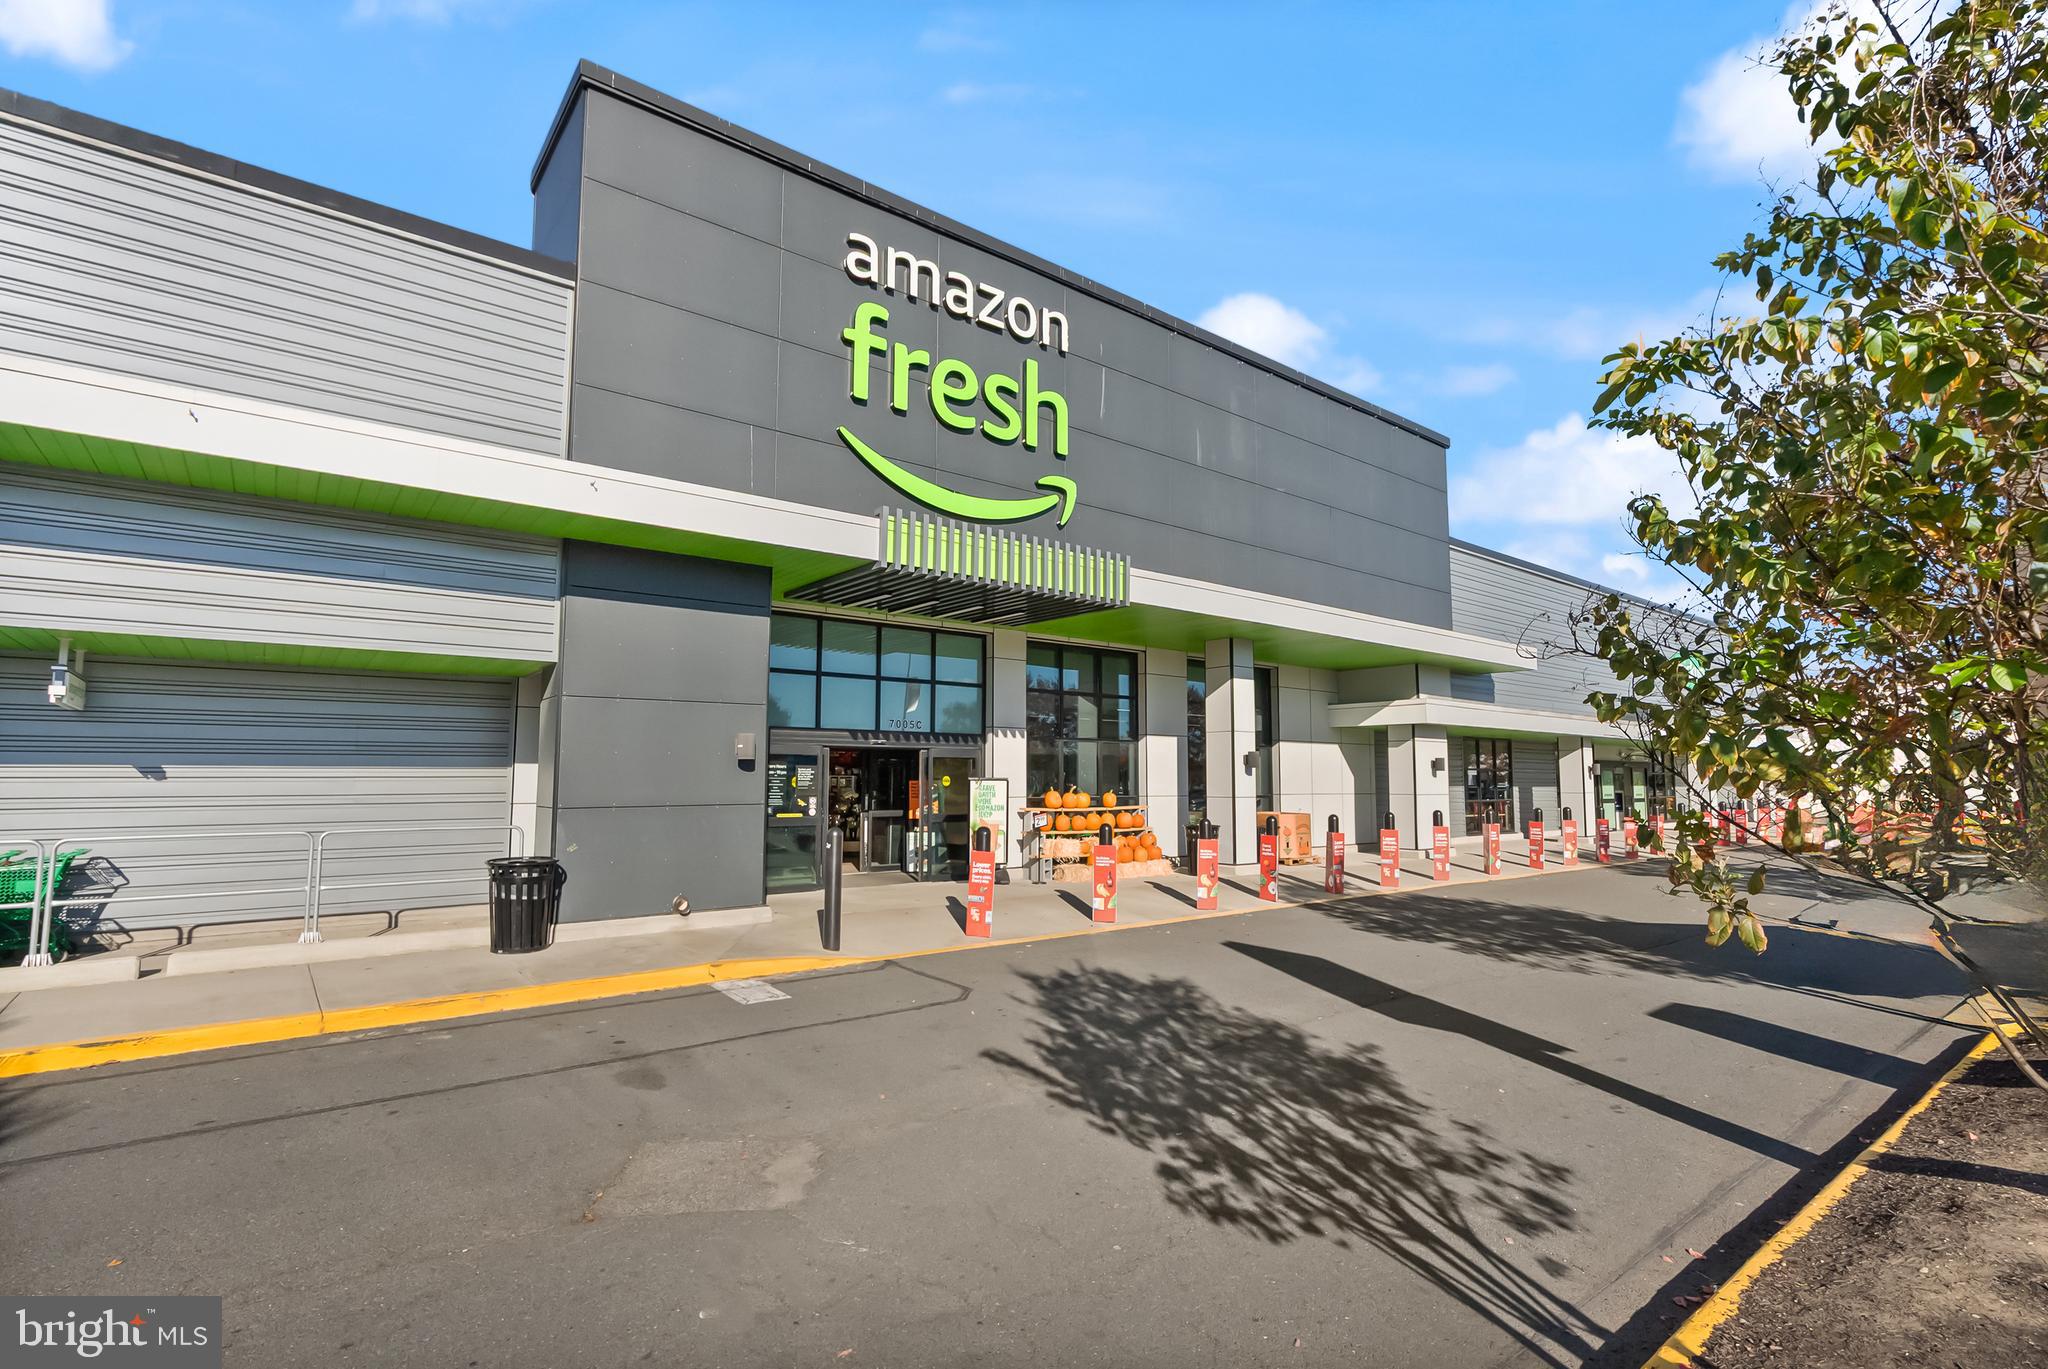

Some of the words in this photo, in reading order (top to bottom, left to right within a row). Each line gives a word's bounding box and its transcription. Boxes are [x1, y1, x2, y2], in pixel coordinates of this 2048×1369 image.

[844, 232, 1069, 352] amazon
[842, 302, 1069, 456] fresh
[889, 719, 922, 730] 7005C
